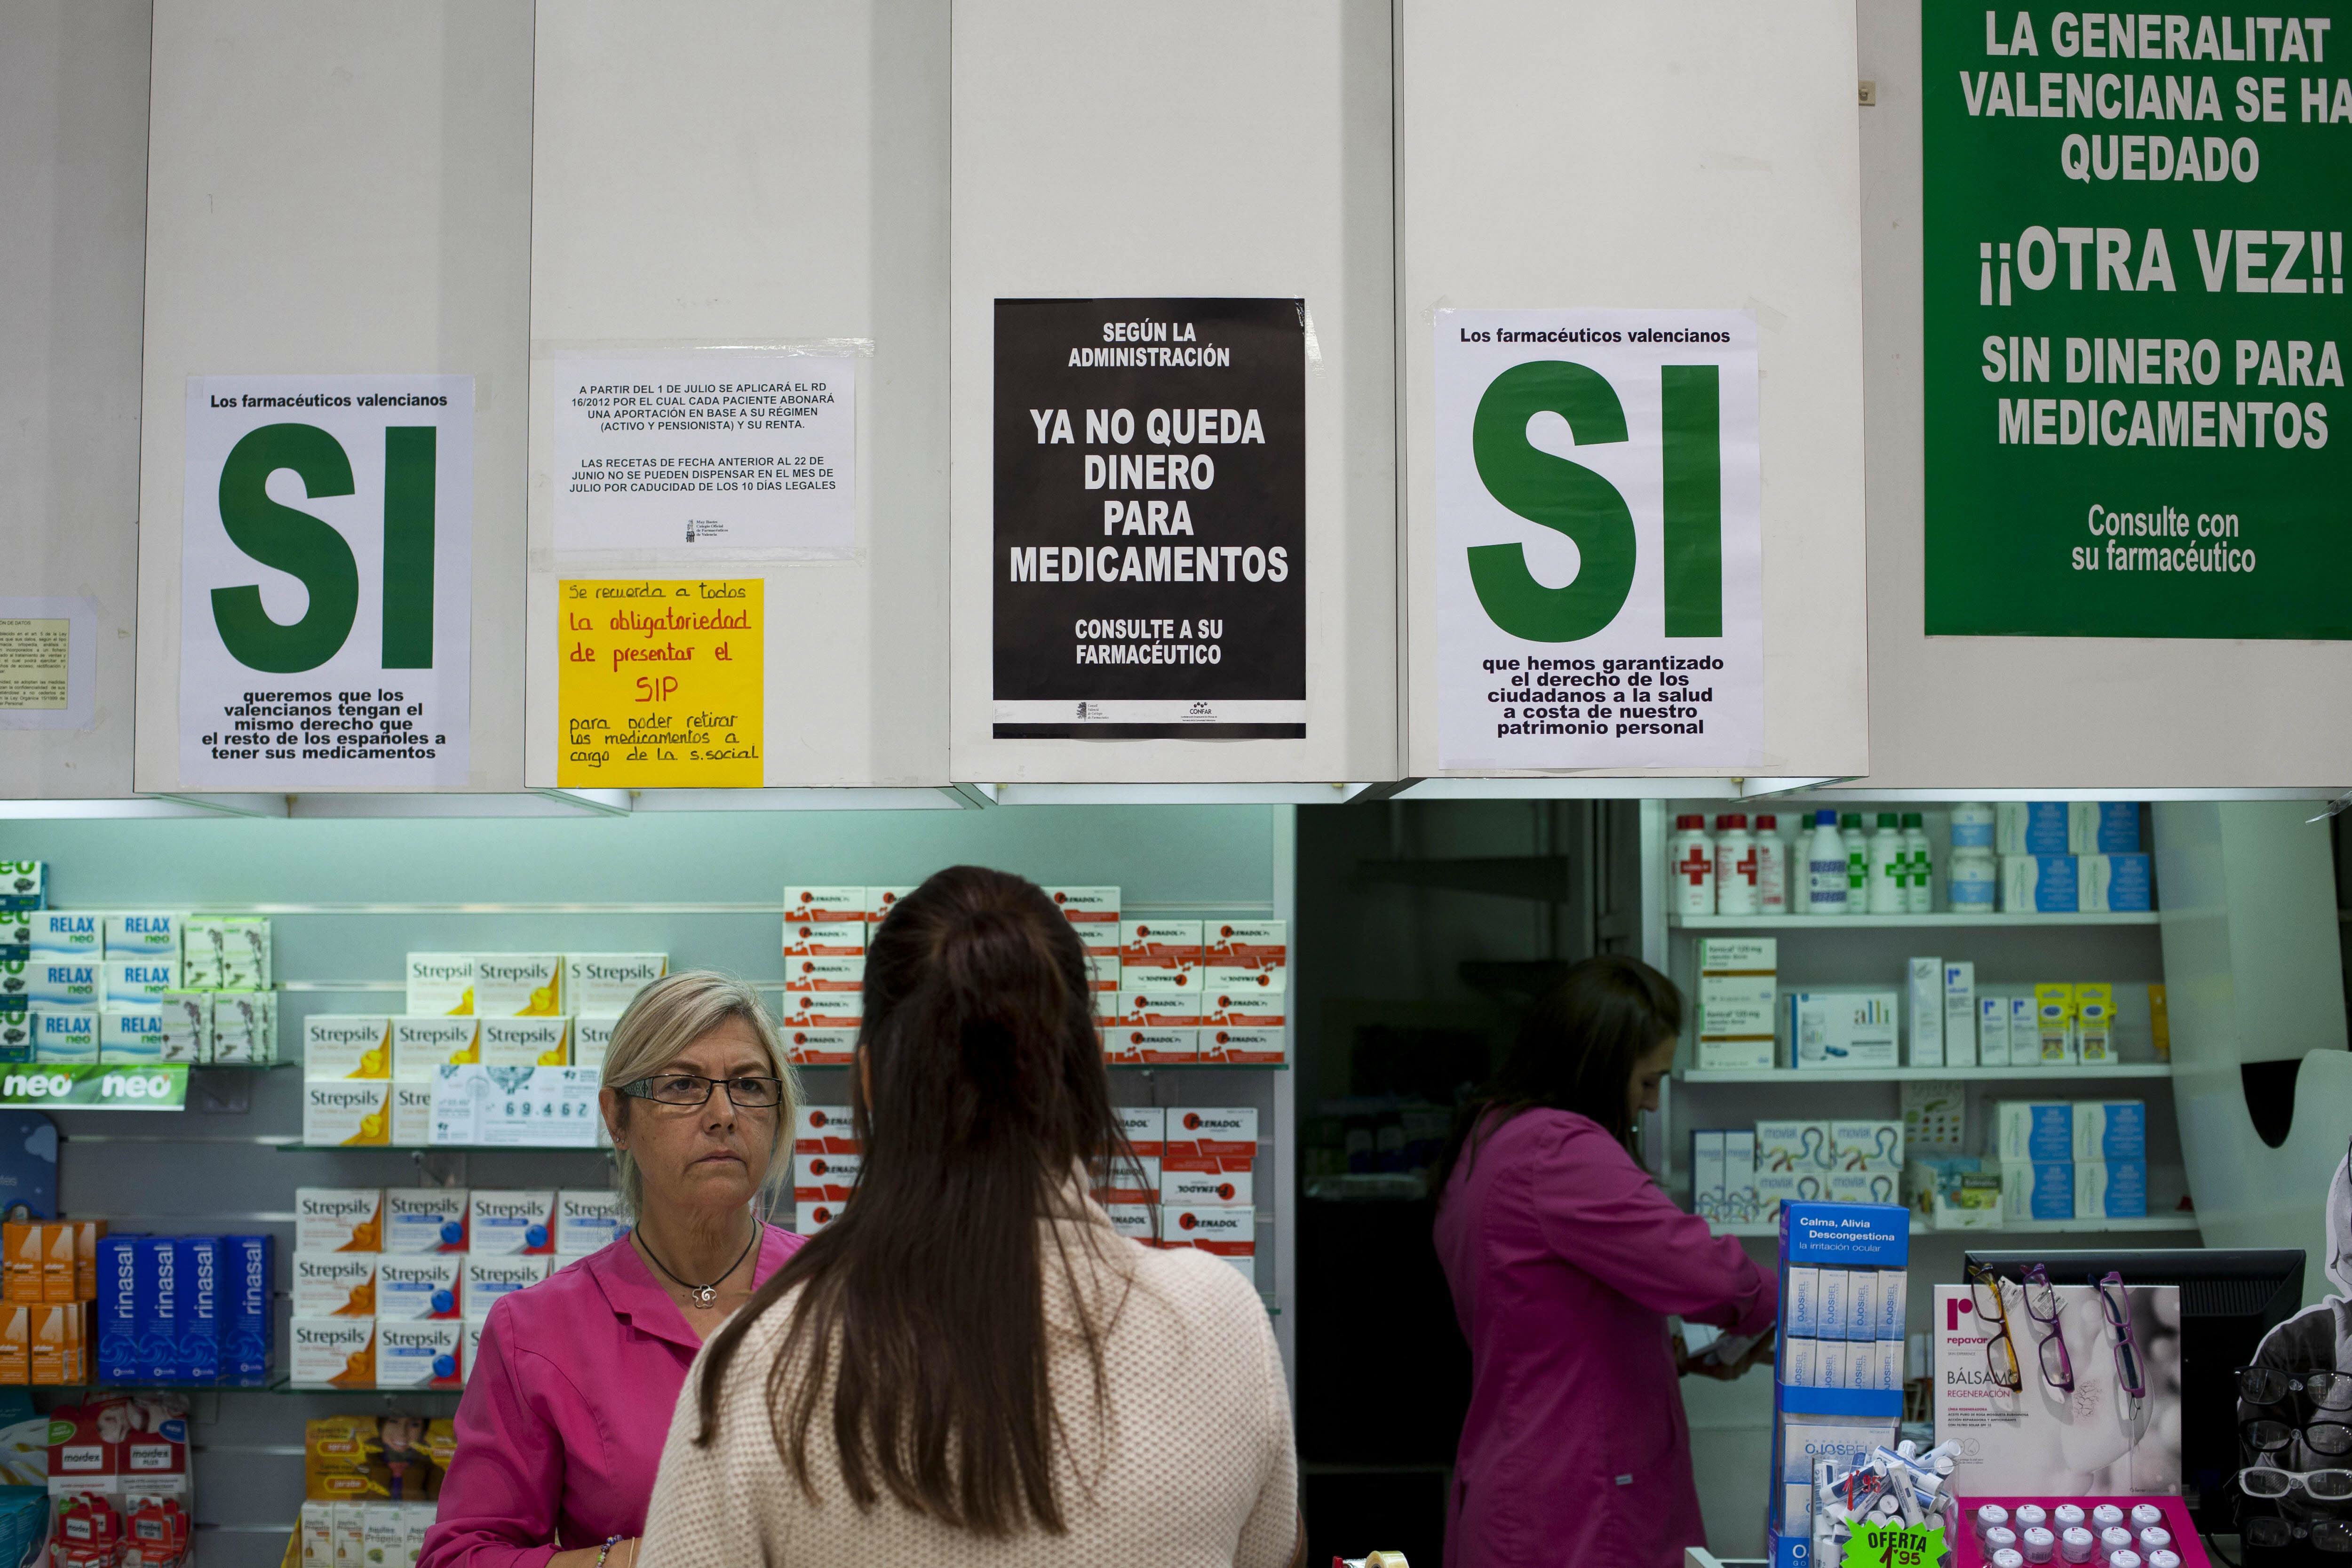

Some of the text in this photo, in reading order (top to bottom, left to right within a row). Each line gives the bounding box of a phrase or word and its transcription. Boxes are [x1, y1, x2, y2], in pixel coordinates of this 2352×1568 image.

[1986, 11, 2330, 62] LA GENERALITAT
[1960, 72, 2352, 123] VALENCIANA SE HA
[2061, 134, 2258, 183] QUEDADO
[2193, 230, 2343, 294] VEZ!!
[1104, 318, 1196, 342] SEGÚN LA
[1461, 328, 1730, 342] Los farmacéuticos valencianos
[1068, 343, 1229, 366] ADMINISTRACIÓN
[1982, 336, 2344, 386] SIN DINERO PARA
[736, 382, 791, 392] APLICARÁ
[211, 393, 447, 407] Los farmacéuticos valencianos
[780, 393, 834, 404] ABONARÁ
[1030, 409, 1265, 446] YA NO QUEDA
[1999, 398, 2328, 449] MEDICAMENTOS
[1085, 454, 1214, 489] DINERO
[1467, 360, 1722, 643] SI
[1104, 501, 1193, 535] PARA
[2089, 504, 2238, 537] Consulte con
[211, 423, 436, 673] SI
[2072, 539, 2255, 572] su farmacéutico
[1011, 546, 1288, 582] MEDICAMENTOS
[570, 585, 587, 598] Se
[596, 582, 666, 598] recuerda
[699, 582, 745, 598] todos
[611, 607, 751, 638] obligatoriedad
[1076, 620, 1222, 639] CONSULTE A SU
[570, 642, 732, 672] de presentar el
[1077, 645, 1221, 664] FARMACÉUTICO
[1483, 655, 1723, 674] que hemos garantizado
[1511, 672, 1689, 686] el derecho de los
[243, 689, 403, 704] queremos que los
[636, 677, 678, 701] SIP
[1488, 688, 1712, 702] ciudadanos a la salud
[224, 703, 422, 719] valencianos tengan el
[1504, 704, 1697, 718] a costa de nuestro
[235, 717, 413, 734] mismo derecho que
[570, 718, 611, 732] para
[687, 711, 738, 728] retirar
[1498, 720, 1703, 738] patrimonio personal
[202, 732, 445, 747] el resto de los españoles a
[605, 730, 709, 744] medicamentos
[725, 733, 739, 743] a
[212, 746, 435, 759] tener sus medicamentos
[571, 751, 609, 767] cargo
[627, 747, 647, 760] de
[50, 917, 94, 933] RELAX
[125, 917, 170, 933] RELAX
[481, 963, 548, 981] Strepsils
[310, 1027, 379, 1045] Strepsils
[3, 1074, 72, 1097] neo
[102, 1074, 171, 1098] neo
[1190, 1115, 1240, 1128] FRENADOL
[302, 1199, 371, 1218] Strepsils
[1186, 1216, 1238, 1228] FRENADOL
[1801, 1218, 1837, 1227] Calma,
[1810, 1230, 1894, 1241] Descongestiona
[1810, 1242, 1849, 1250] irritación
[113, 1244, 134, 1318] rinasal
[193, 1244, 214, 1318] rinasal
[1797, 1281, 1806, 1322] OJOSBEL
[1886, 1283, 1895, 1325] OJOSBEL
[383, 1329, 452, 1348] Strepsils
[1947, 1337, 1988, 1346] repavar
[1947, 1389, 2010, 1398] REGENERACIÓN
[1867, 1532, 1927, 1552] OFERTA
